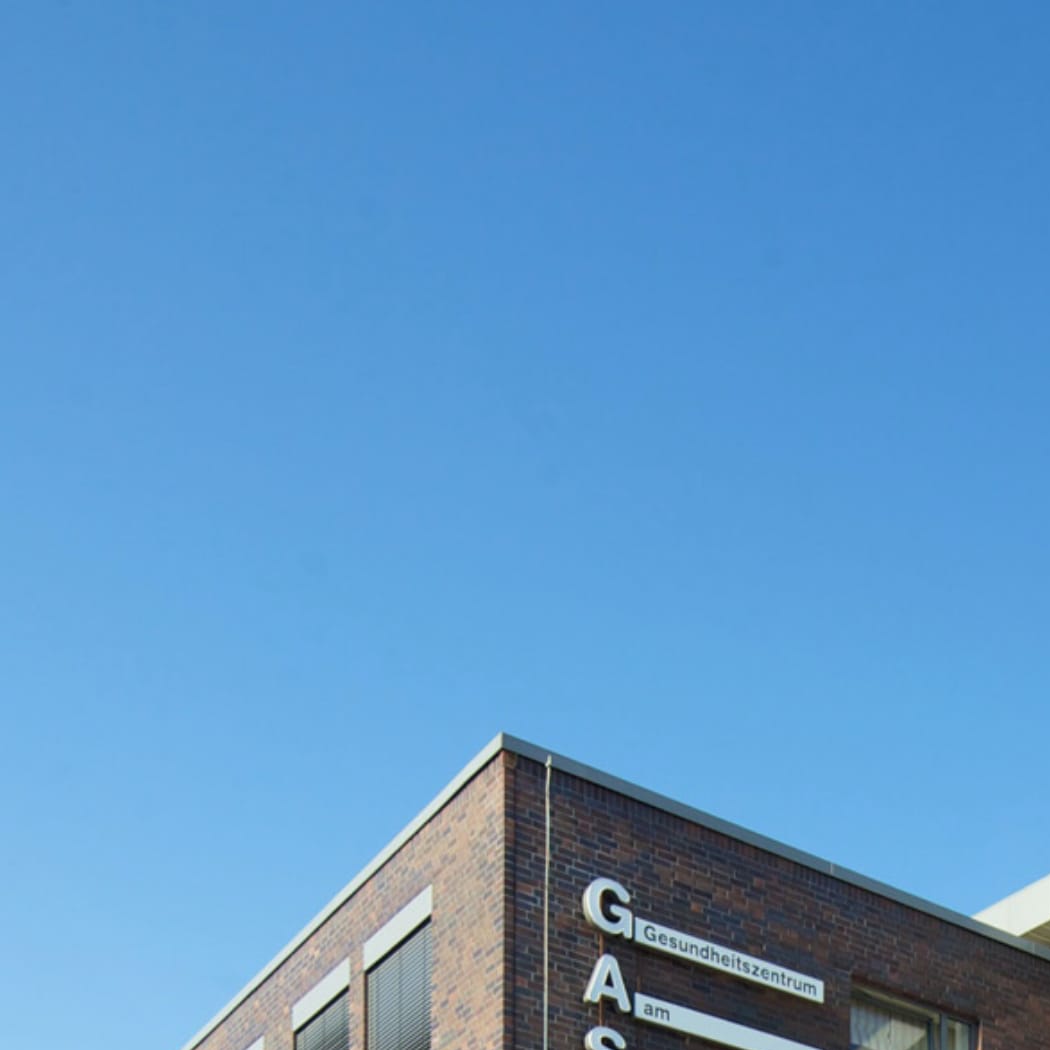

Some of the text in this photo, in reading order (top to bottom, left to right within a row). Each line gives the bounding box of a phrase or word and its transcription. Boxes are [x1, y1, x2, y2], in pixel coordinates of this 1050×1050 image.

[583, 877, 818, 998] G Gesundheitszentrum
[583, 953, 670, 1021] A am
